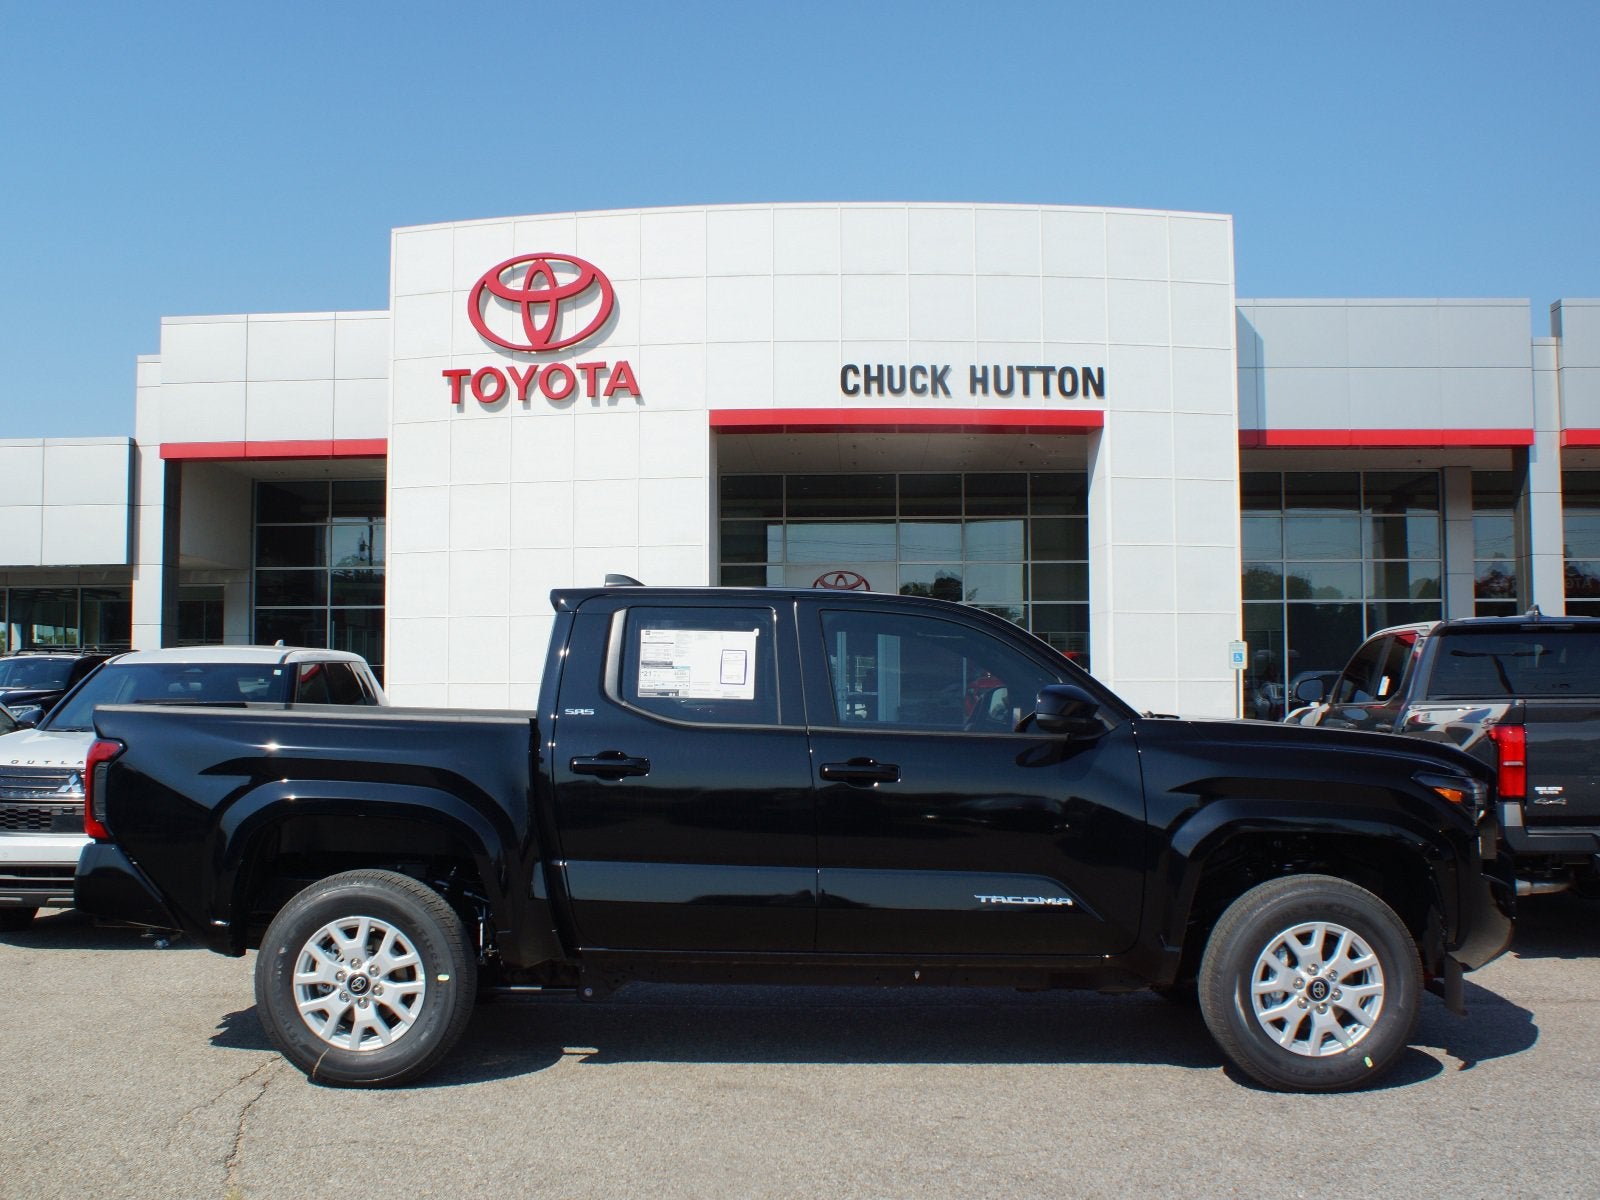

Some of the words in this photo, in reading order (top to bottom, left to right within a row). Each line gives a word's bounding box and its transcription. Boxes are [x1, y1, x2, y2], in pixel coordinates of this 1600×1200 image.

[442, 361, 640, 404] TOYOTA
[840, 364, 951, 395] CHUCK
[969, 365, 1104, 397] HUTTON
[973, 894, 1073, 906] TACOMA
